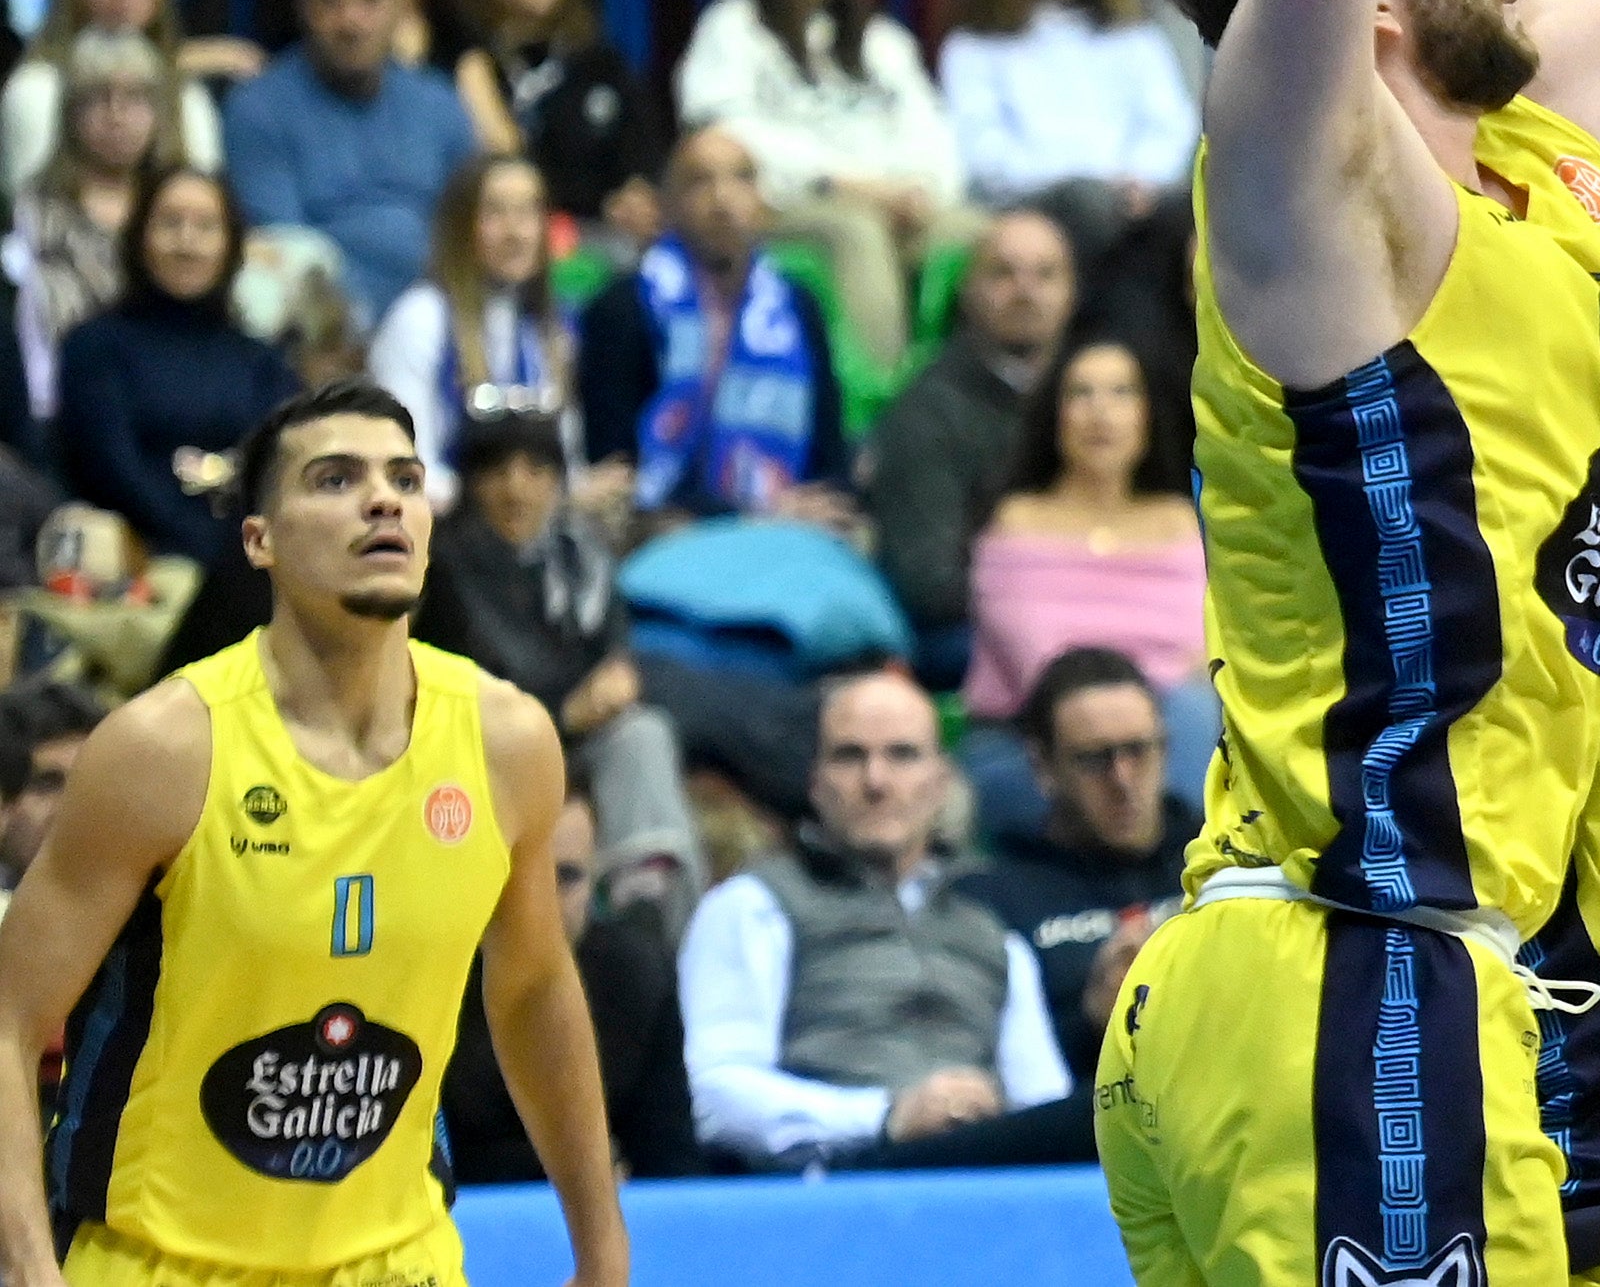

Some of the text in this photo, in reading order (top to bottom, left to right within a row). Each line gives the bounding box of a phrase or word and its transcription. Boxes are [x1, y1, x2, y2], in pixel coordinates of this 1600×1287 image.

[330, 874, 375, 959] 0
[245, 1049, 401, 1098] Estrella
[246, 1091, 384, 1140] Galicia
